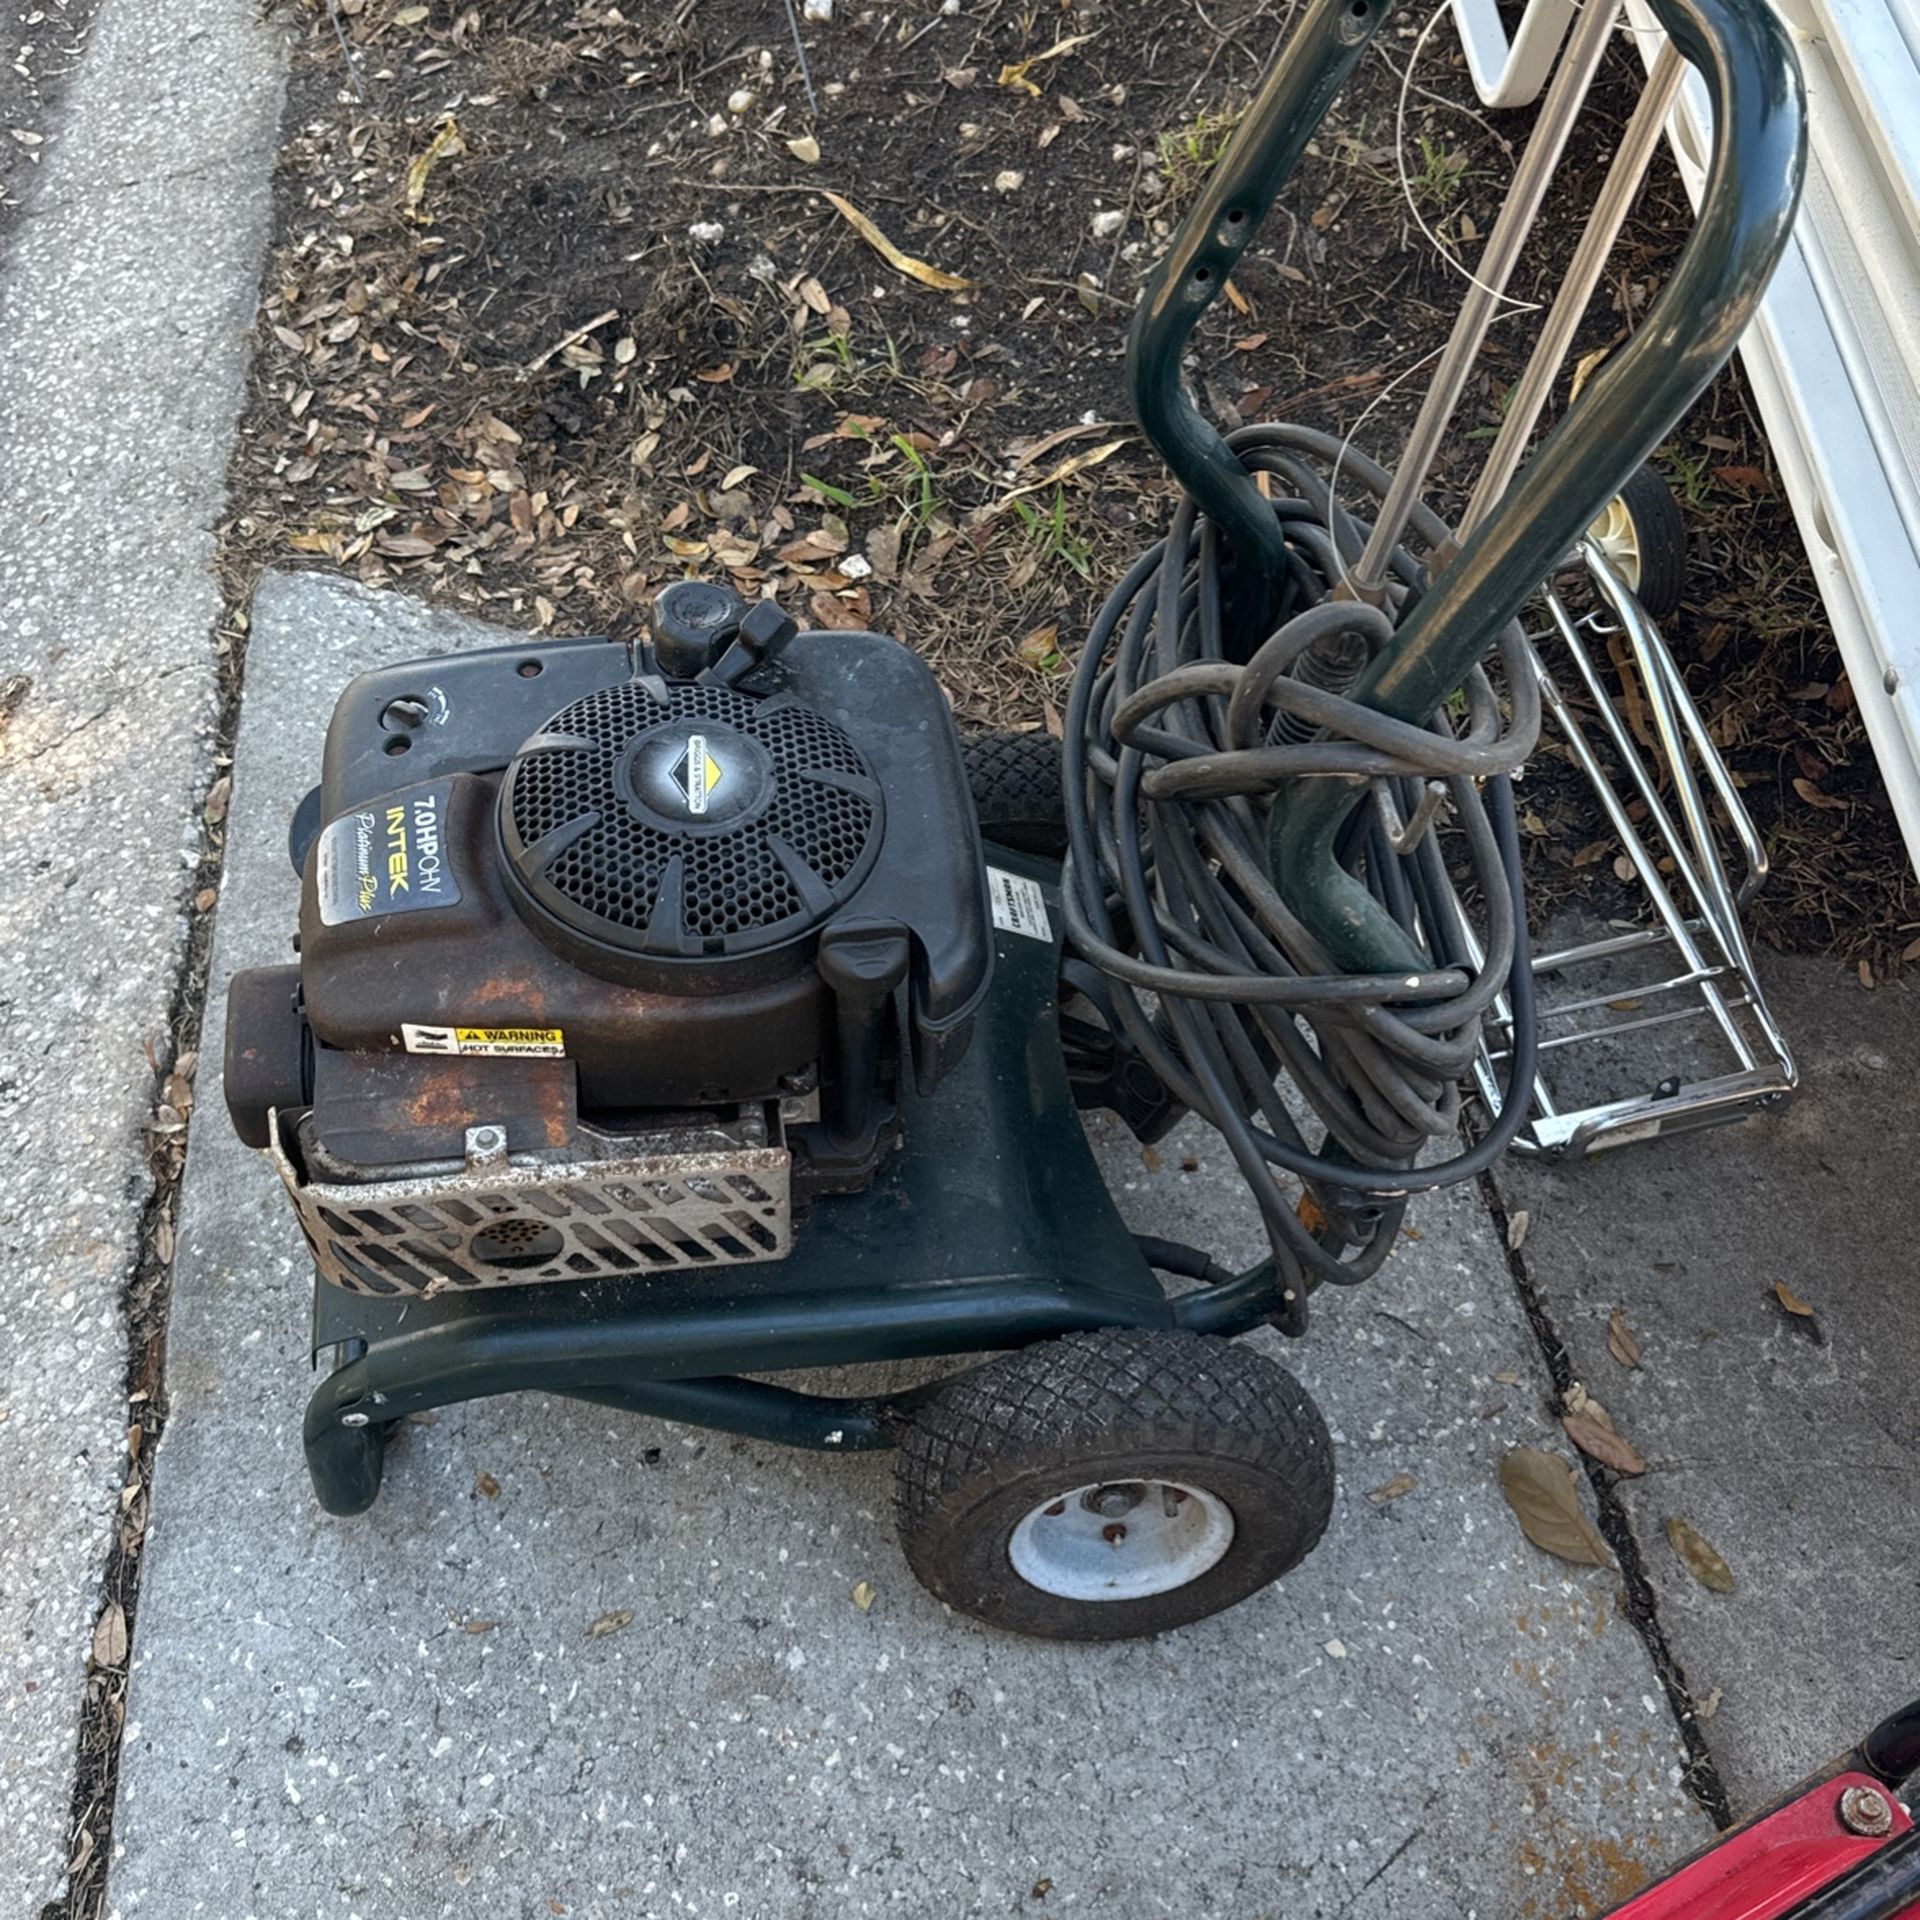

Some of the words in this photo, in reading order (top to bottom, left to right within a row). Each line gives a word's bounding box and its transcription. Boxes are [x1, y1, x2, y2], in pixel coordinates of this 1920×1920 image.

[386, 805, 410, 896] INTEK
[484, 1030, 557, 1042] WARNING
[463, 1043, 489, 1052] HOT
